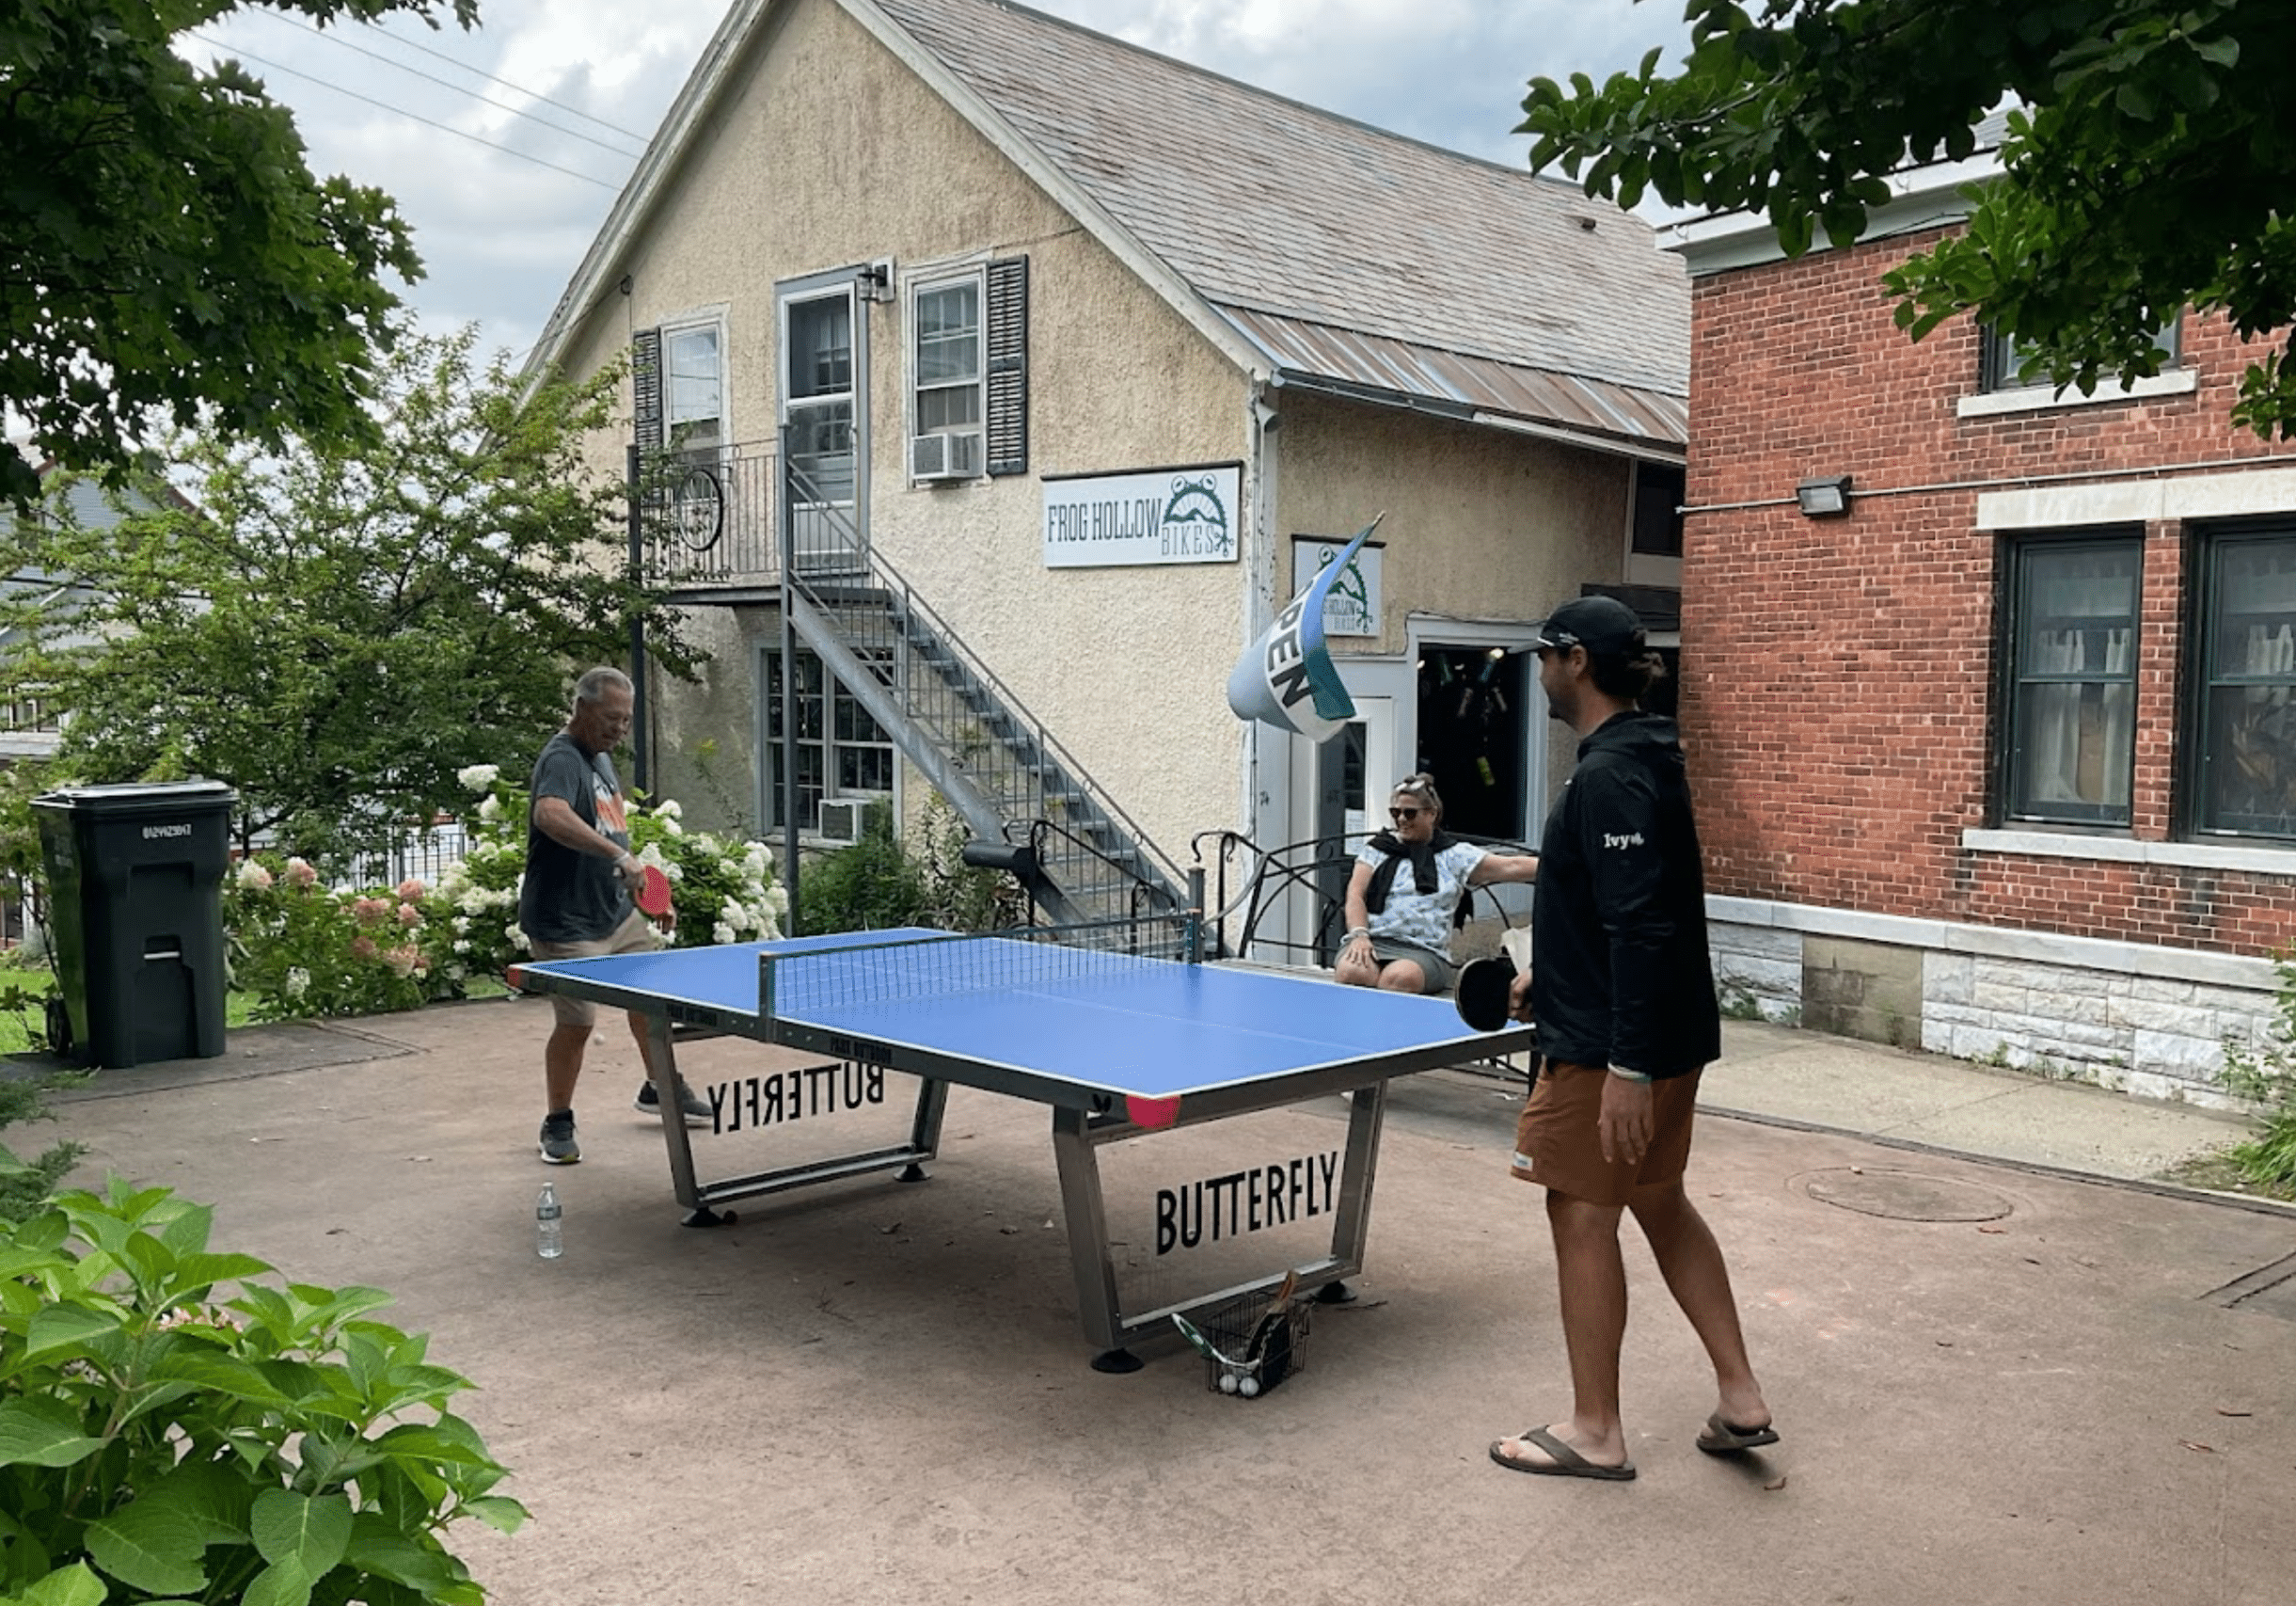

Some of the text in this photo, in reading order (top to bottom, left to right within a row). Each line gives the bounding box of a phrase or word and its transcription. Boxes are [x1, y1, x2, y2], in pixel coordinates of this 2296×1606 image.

[1048, 498, 1163, 542] FROG HOLLOW
[1162, 525, 1213, 555] BIKES
[1268, 580, 1313, 708] PEN
[1156, 1151, 1338, 1256] BUTTERFLY
